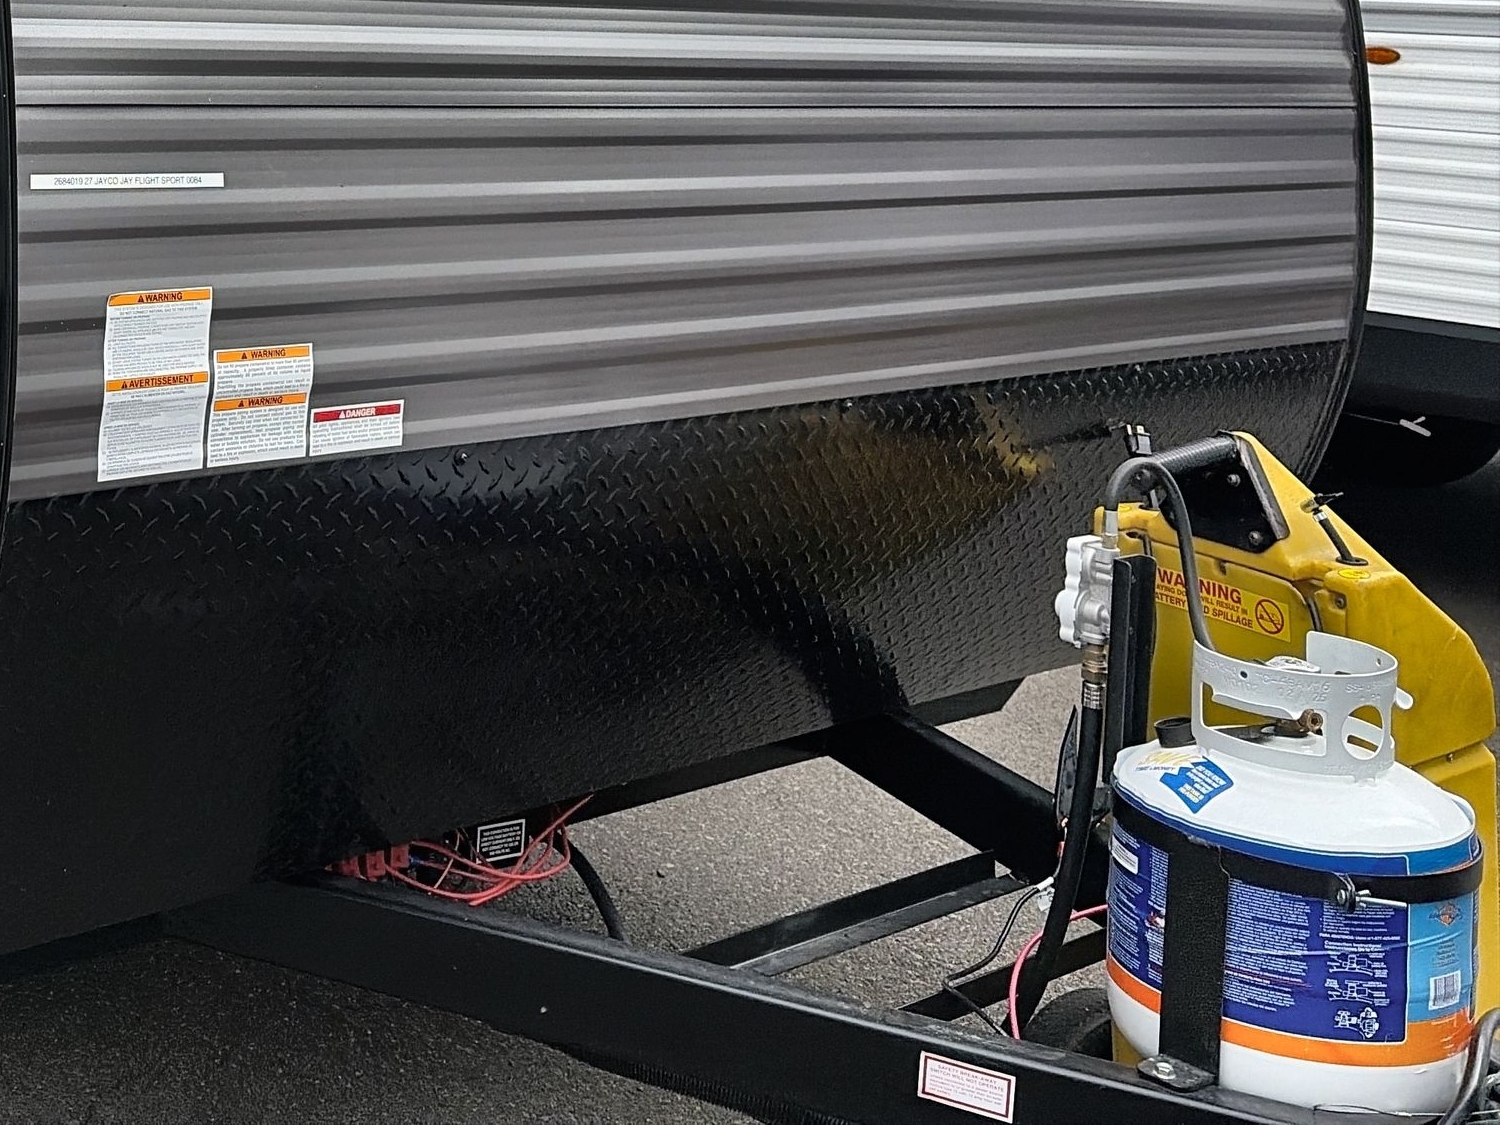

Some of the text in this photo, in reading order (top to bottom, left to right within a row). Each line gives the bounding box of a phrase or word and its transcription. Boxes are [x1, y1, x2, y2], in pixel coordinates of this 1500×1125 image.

[84, 177, 93, 185] 27
[94, 177, 119, 185] JAYCO
[120, 177, 133, 185] JAY
[134, 176, 159, 185] FLIGHT
[161, 176, 185, 184] SPORT
[145, 291, 183, 302] WARNING
[250, 348, 286, 359] WARNING
[129, 374, 194, 388] AVERTISSEMENT
[248, 396, 283, 407] WARNING
[346, 408, 376, 418] DANGER
[1157, 567, 1241, 605] WANING
[1156, 592, 1186, 609] ATTERY
[1212, 608, 1254, 629] SPILLAGE
[1216, 600, 1240, 613] RESULT
[937, 1064, 958, 1074] SAFETY
[965, 1077, 977, 1085] NOT
[979, 1081, 1004, 1093] OPERATE
